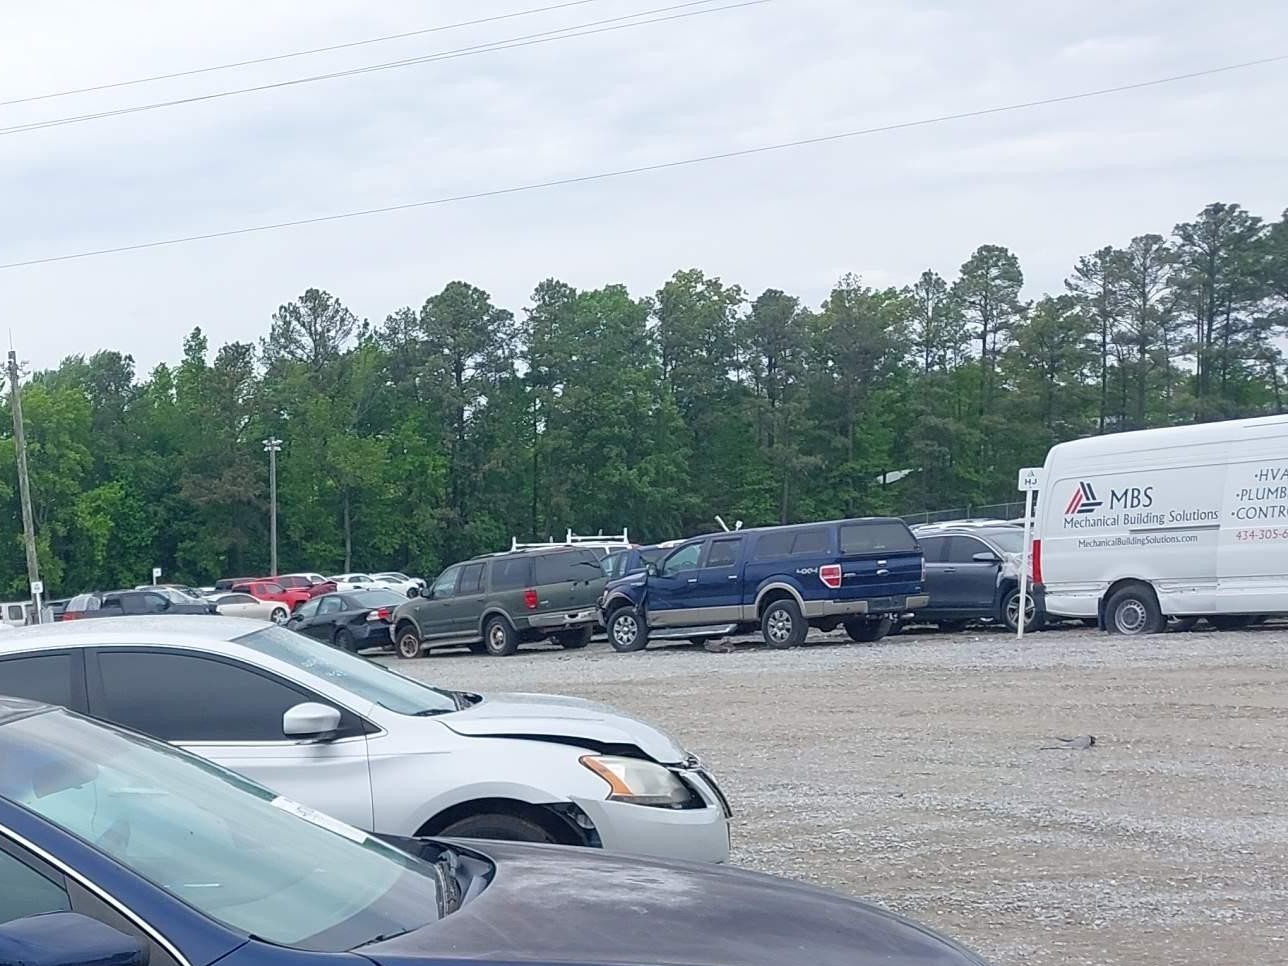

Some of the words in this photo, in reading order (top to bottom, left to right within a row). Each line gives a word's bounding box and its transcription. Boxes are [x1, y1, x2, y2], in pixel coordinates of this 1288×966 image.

[1110, 486, 1154, 510] MBS
[1063, 515, 1120, 529] Mechanical
[1123, 512, 1166, 526] Building
[1168, 509, 1219, 523] Solutions
[1236, 505, 1288, 520] CONTR
[1078, 535, 1198, 548] MechanicalBuildingSolutions.com
